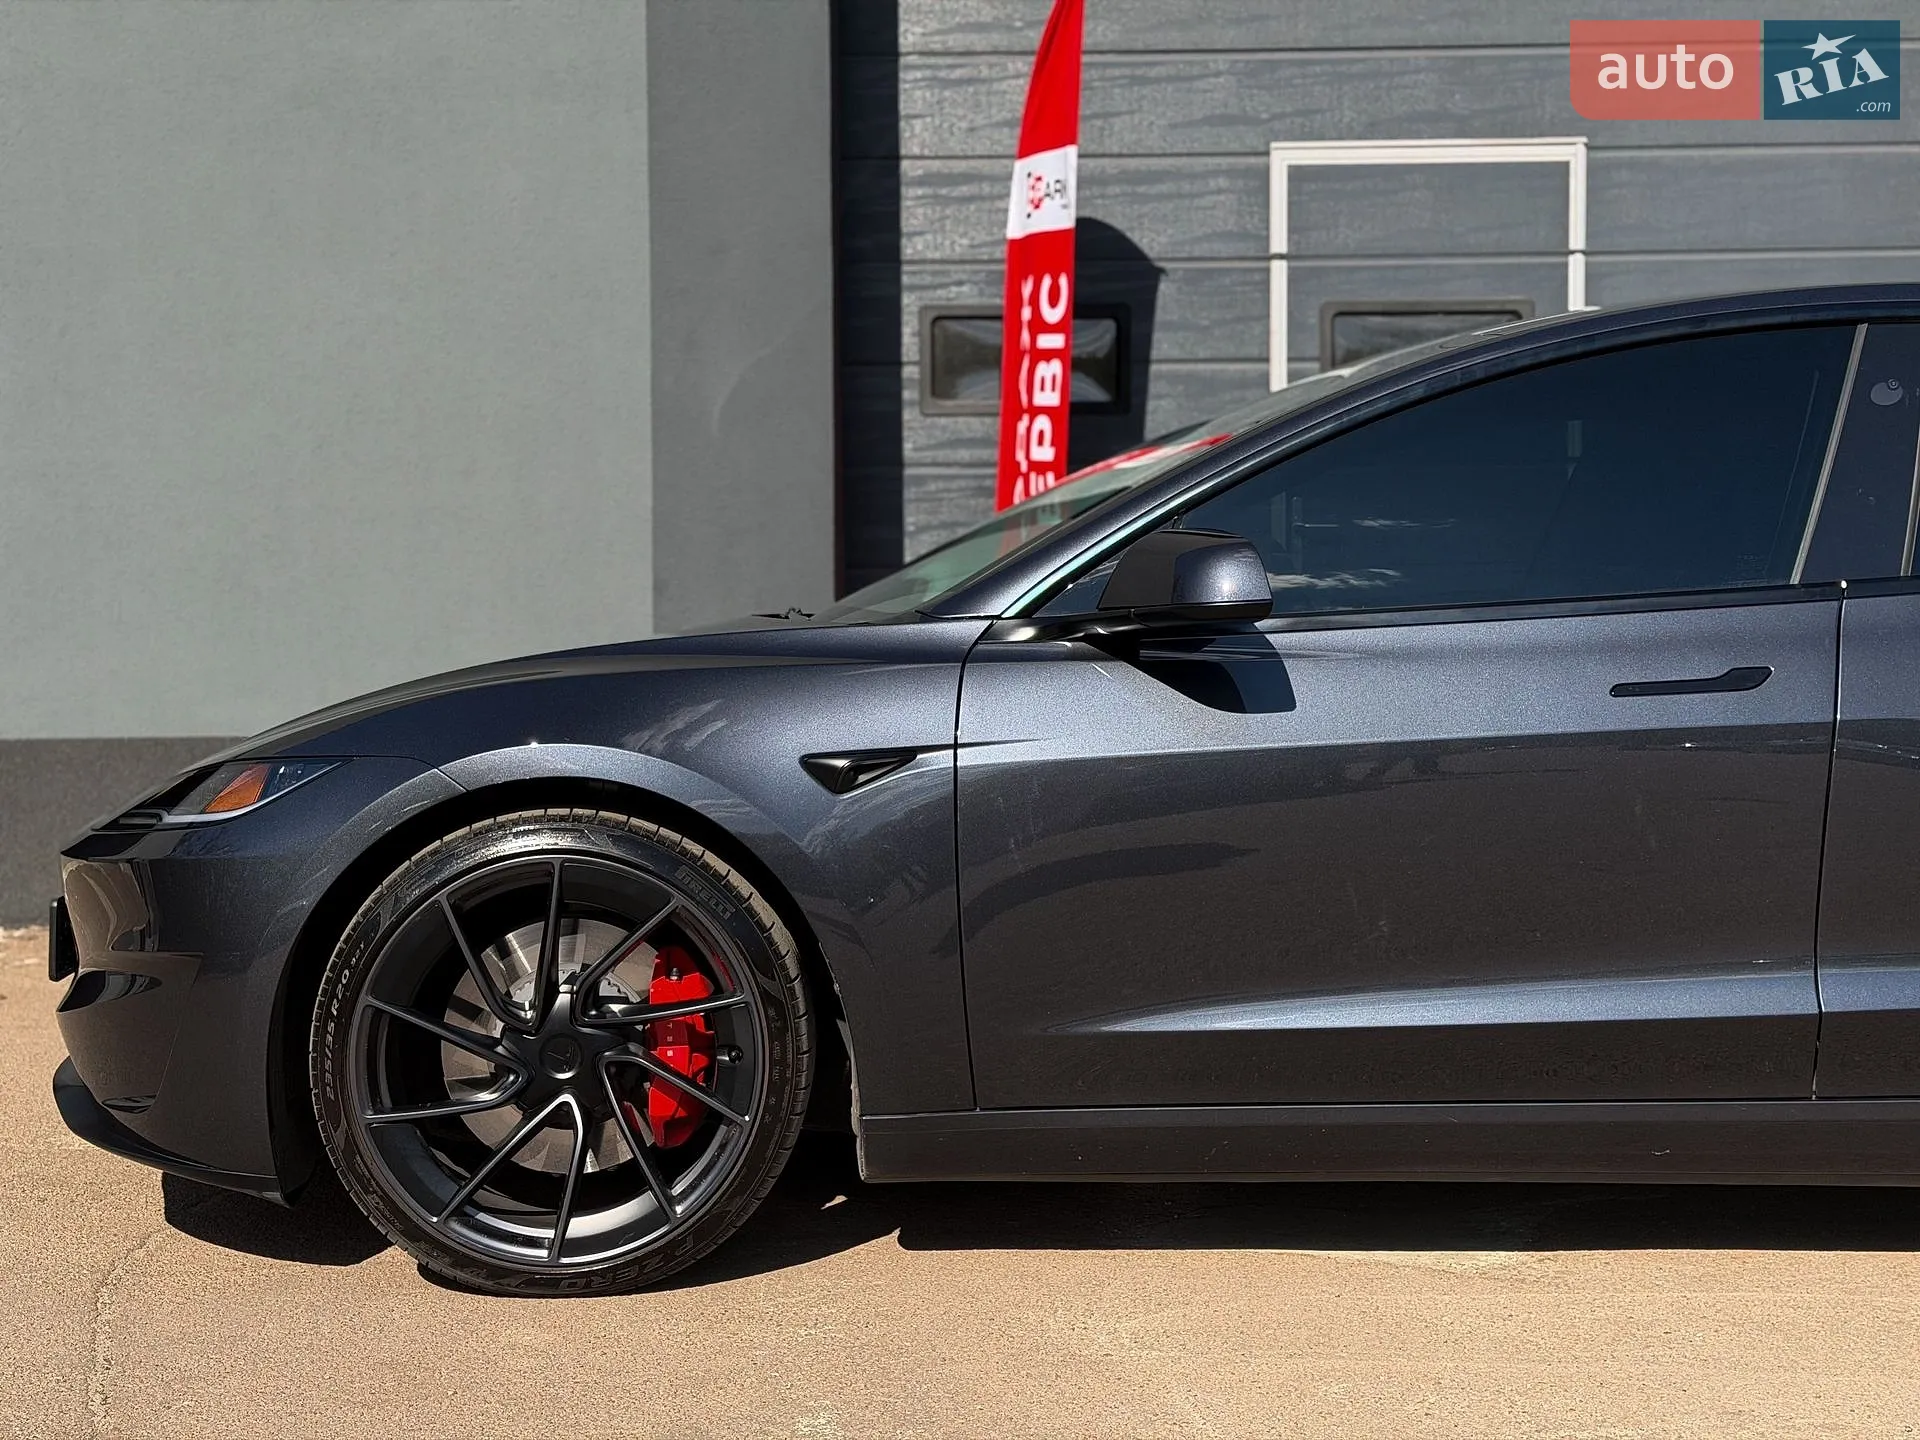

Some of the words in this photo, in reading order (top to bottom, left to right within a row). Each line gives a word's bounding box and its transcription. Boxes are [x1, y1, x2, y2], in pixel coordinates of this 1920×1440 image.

[675, 865, 735, 919] PIRELLI
[324, 1019, 336, 1101] 235/35
[331, 968, 350, 1016] R20
[558, 1254, 665, 1290] ZERO
